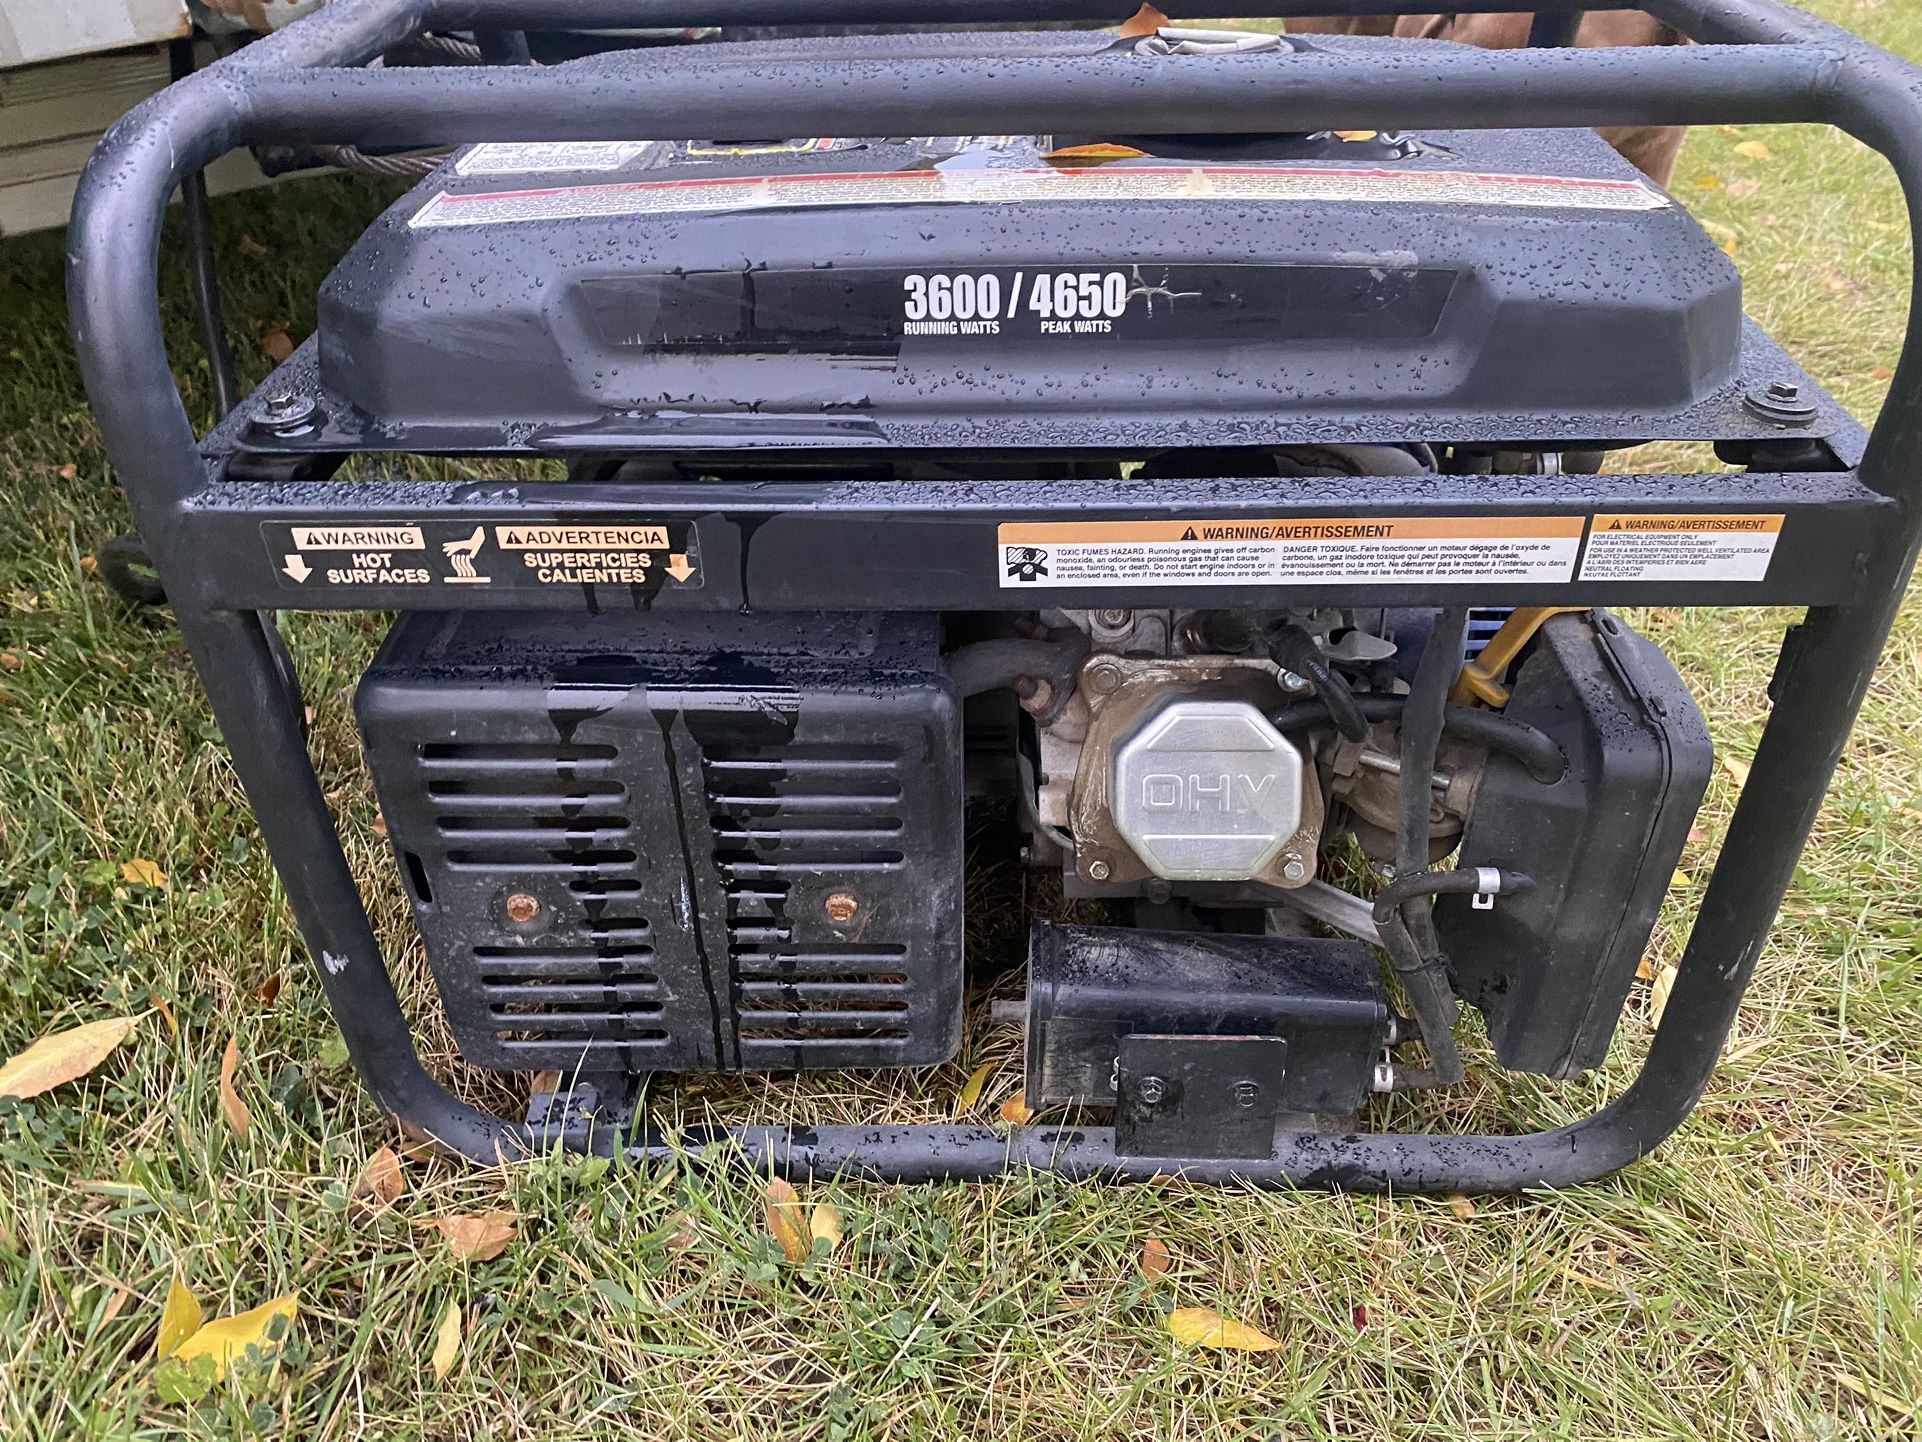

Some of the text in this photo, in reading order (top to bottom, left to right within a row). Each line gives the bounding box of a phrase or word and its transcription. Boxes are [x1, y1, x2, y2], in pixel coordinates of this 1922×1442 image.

[903, 320, 1000, 335] RUNNING WATTS
[1040, 319, 1112, 334] PEAK WATTS
[1203, 525, 1394, 540] WARNING/AVERTISSEMENT
[1625, 520, 1766, 530] WARNING/AVERTISSEMENT
[322, 531, 415, 545] WARNING
[525, 530, 664, 545] ADVERTENCIA
[1056, 548, 1080, 556] TOXIC
[1148, 548, 1180, 556] Running
[1182, 547, 1212, 555] engines
[1214, 547, 1234, 555] gives
[1469, 544, 1498, 552] dégage
[352, 553, 391, 569] HOT
[523, 552, 652, 568] SUPERFICIES
[326, 568, 430, 584] SURFACES
[537, 568, 646, 583] CALIENTES
[1141, 774, 1275, 815] OHV
